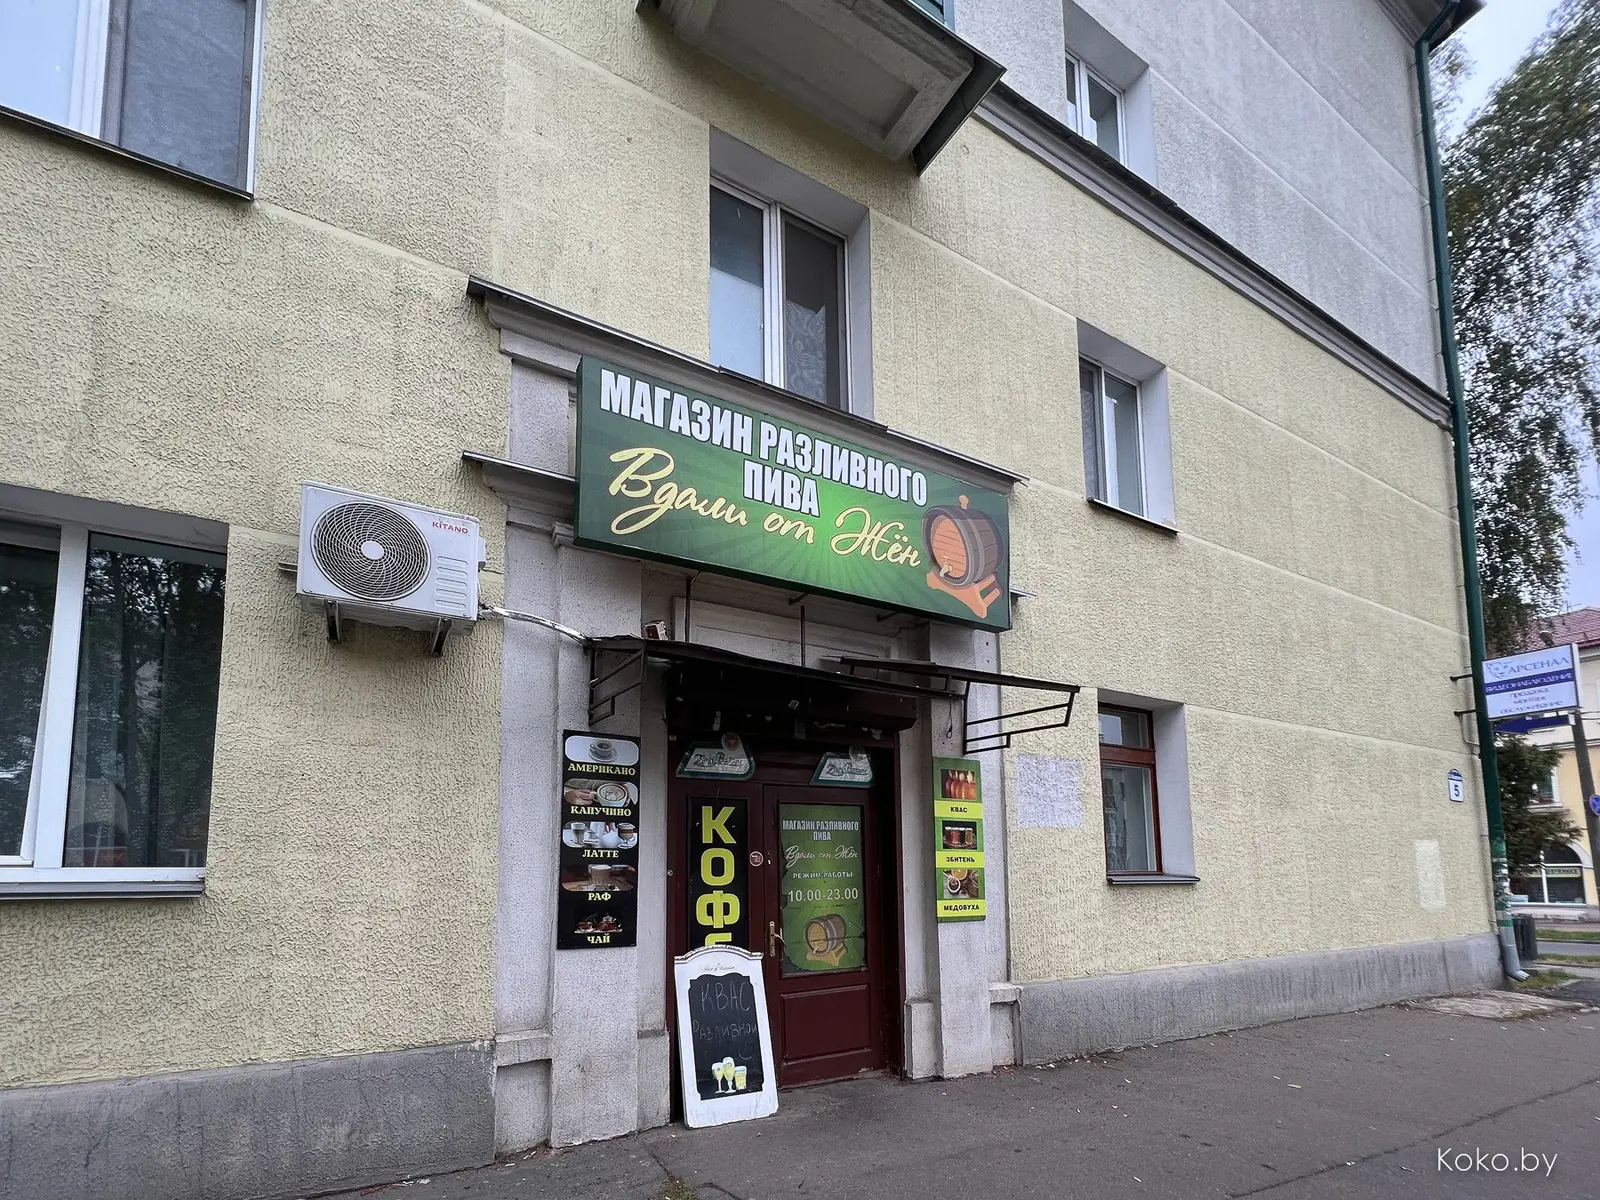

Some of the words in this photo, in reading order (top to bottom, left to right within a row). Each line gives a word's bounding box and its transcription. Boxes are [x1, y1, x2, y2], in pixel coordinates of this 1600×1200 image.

[600, 369, 753, 455] МАГАЗИН
[759, 420, 927, 506] РАЗЛИВНОГО
[743, 459, 820, 517] ПИВА
[608, 447, 748, 535] Вдали
[762, 514, 815, 545] от
[829, 506, 921, 568] Жён
[432, 521, 469, 534] KITANO
[1508, 656, 1569, 675] АРСЕНАЛ
[567, 763, 636, 776] АМЕРИКАНО
[1453, 784, 1461, 797] 5
[570, 805, 632, 817] КАПУЧИНО
[950, 806, 968, 814] КВАС
[782, 820, 815, 831] МАГАЗИН
[816, 821, 859, 831] РАЗЛИВНОГО
[813, 831, 832, 841] ПИВА
[582, 849, 619, 858] ЛАТТЕ
[587, 892, 612, 902] РАФ
[788, 887, 859, 902] 10.00-23.00
[943, 904, 980, 912] МЕДОВУХА
[586, 933, 611, 944] ЧАЙ
[701, 981, 750, 1013] КВАС
